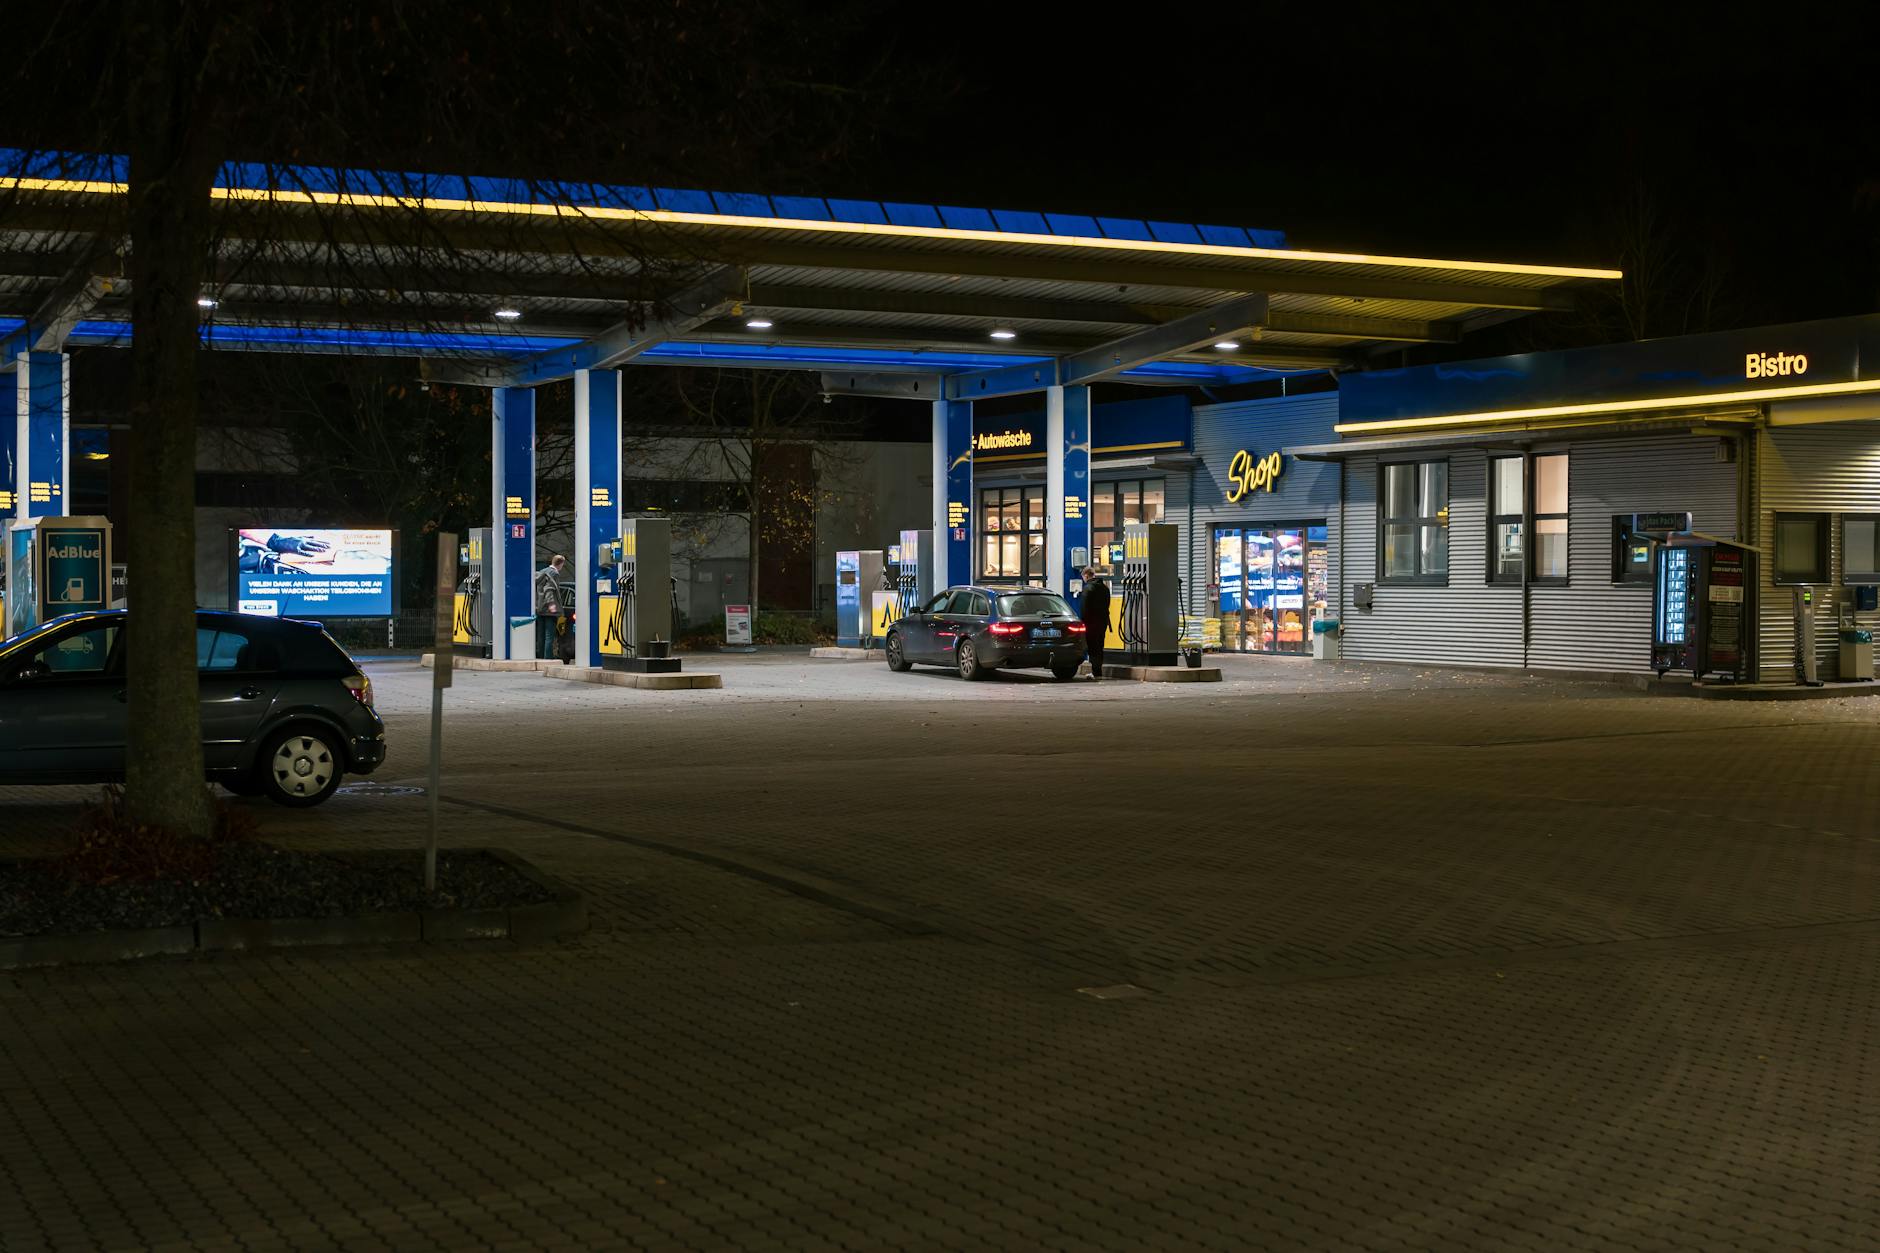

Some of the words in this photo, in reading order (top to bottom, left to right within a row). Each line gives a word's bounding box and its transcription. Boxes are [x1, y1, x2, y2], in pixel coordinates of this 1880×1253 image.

[1746, 352, 1807, 378] Bistro
[978, 429, 1032, 450] Autowäsche
[1227, 450, 1280, 502] Shop
[49, 546, 102, 559] AdBlue
